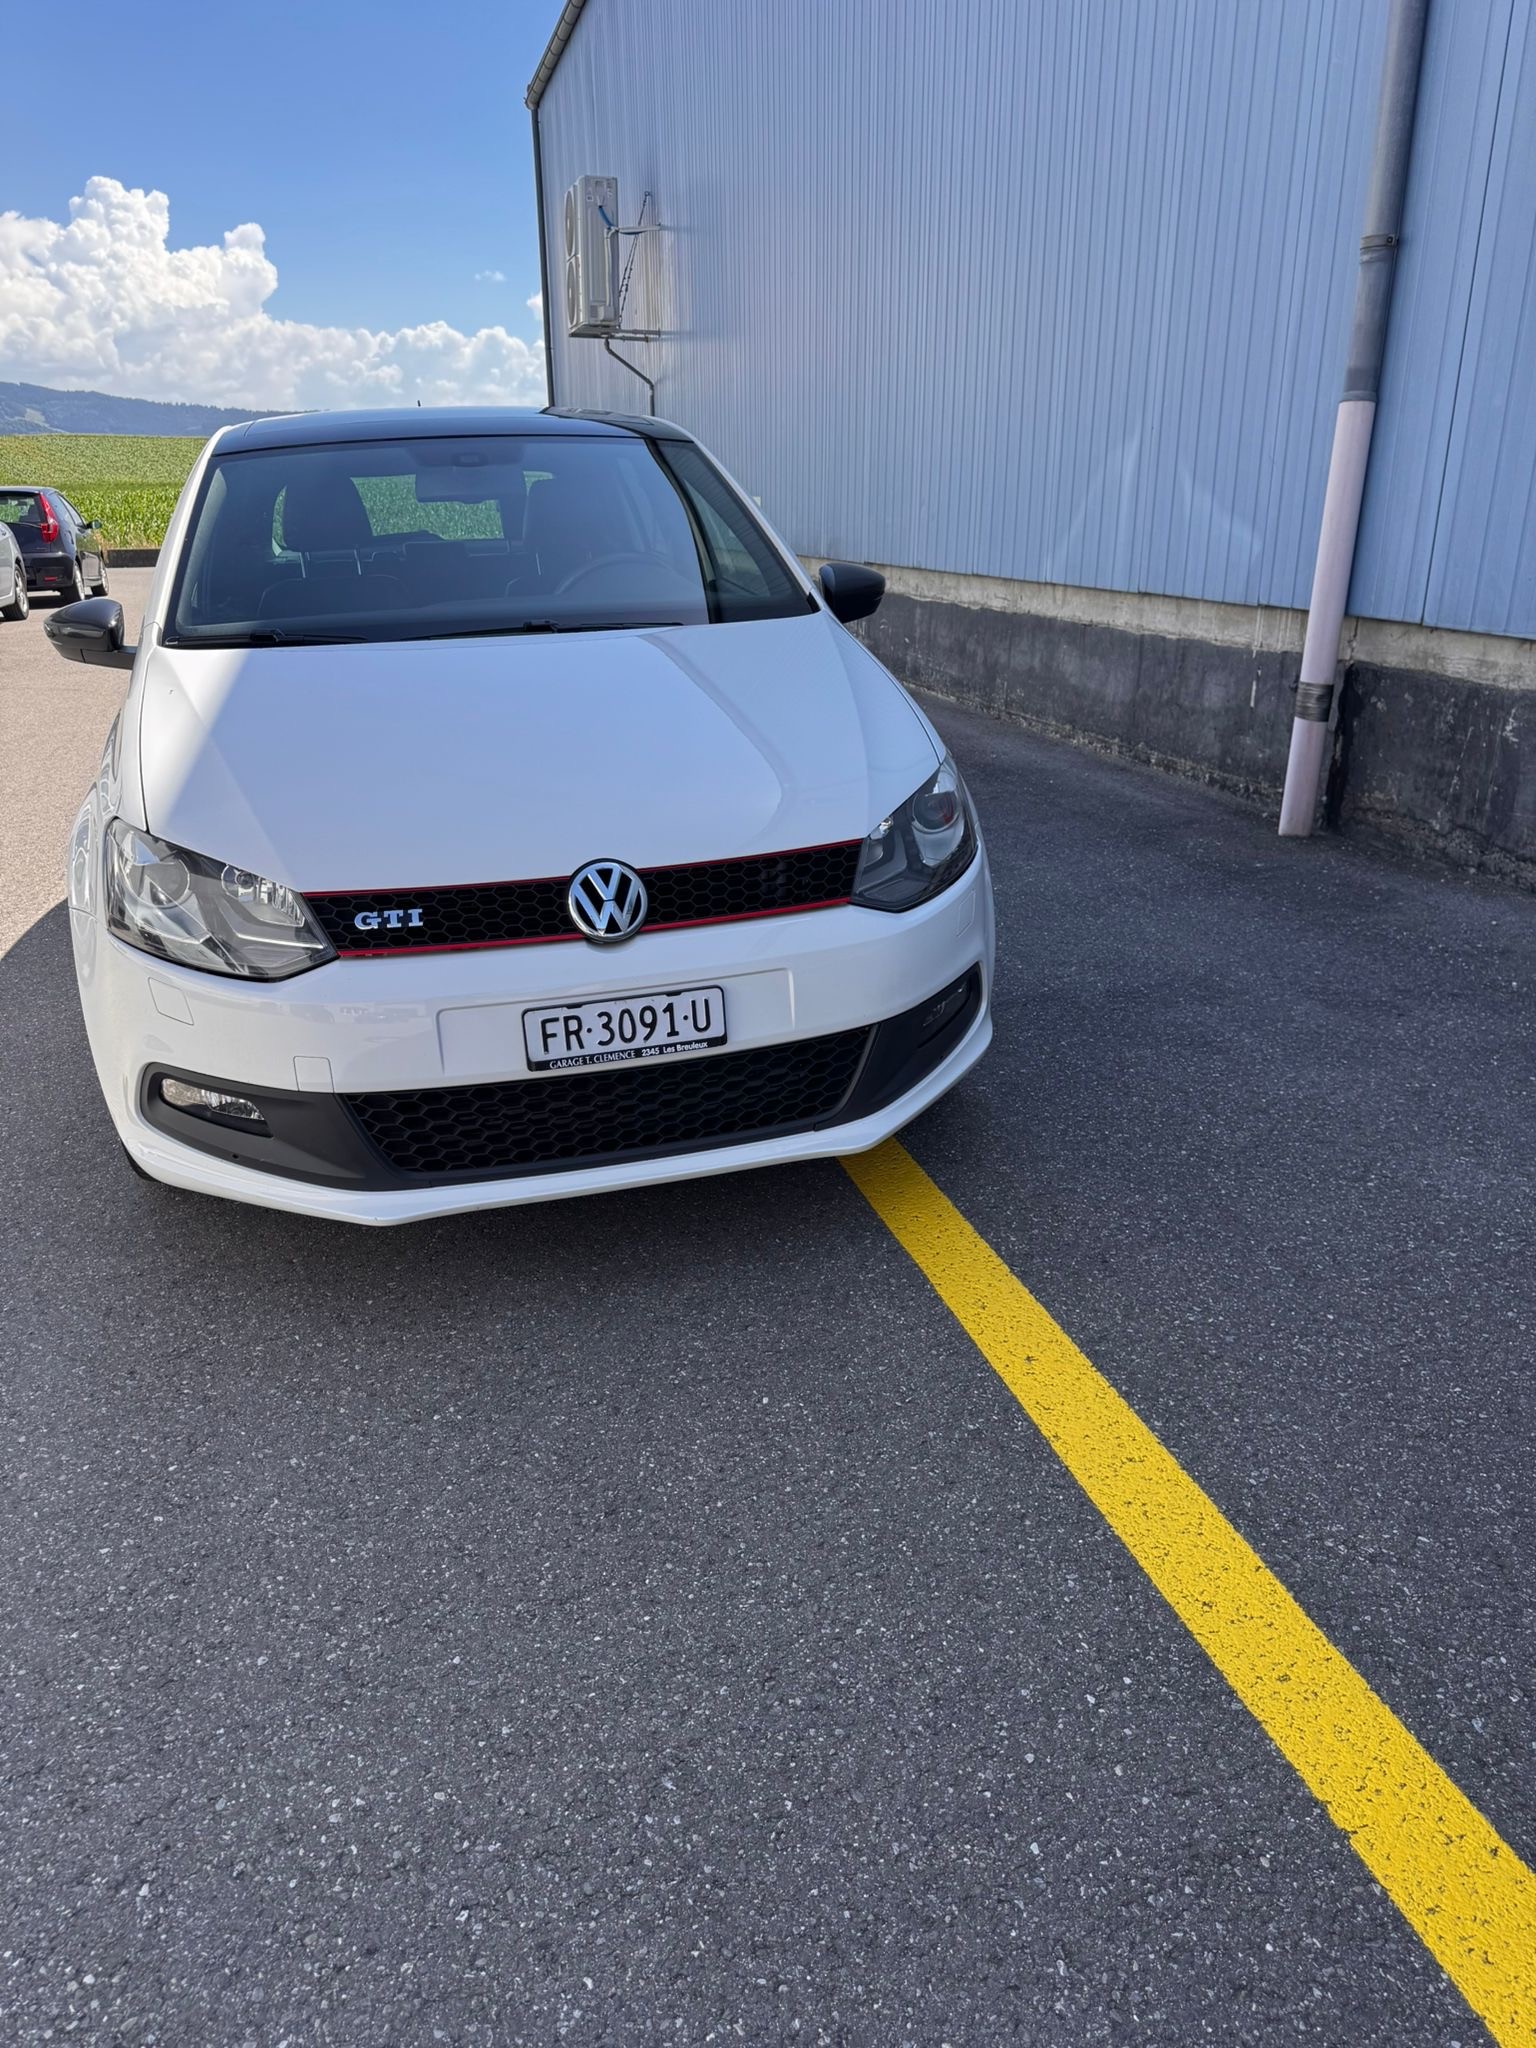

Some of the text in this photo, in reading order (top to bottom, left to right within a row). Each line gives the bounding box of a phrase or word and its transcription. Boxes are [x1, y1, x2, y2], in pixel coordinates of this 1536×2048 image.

[571, 861, 643, 937] VW
[354, 908, 424, 930] GTI
[549, 1041, 708, 1070] GARAGE T. CLEMENCE 2345 Les Breuleux
